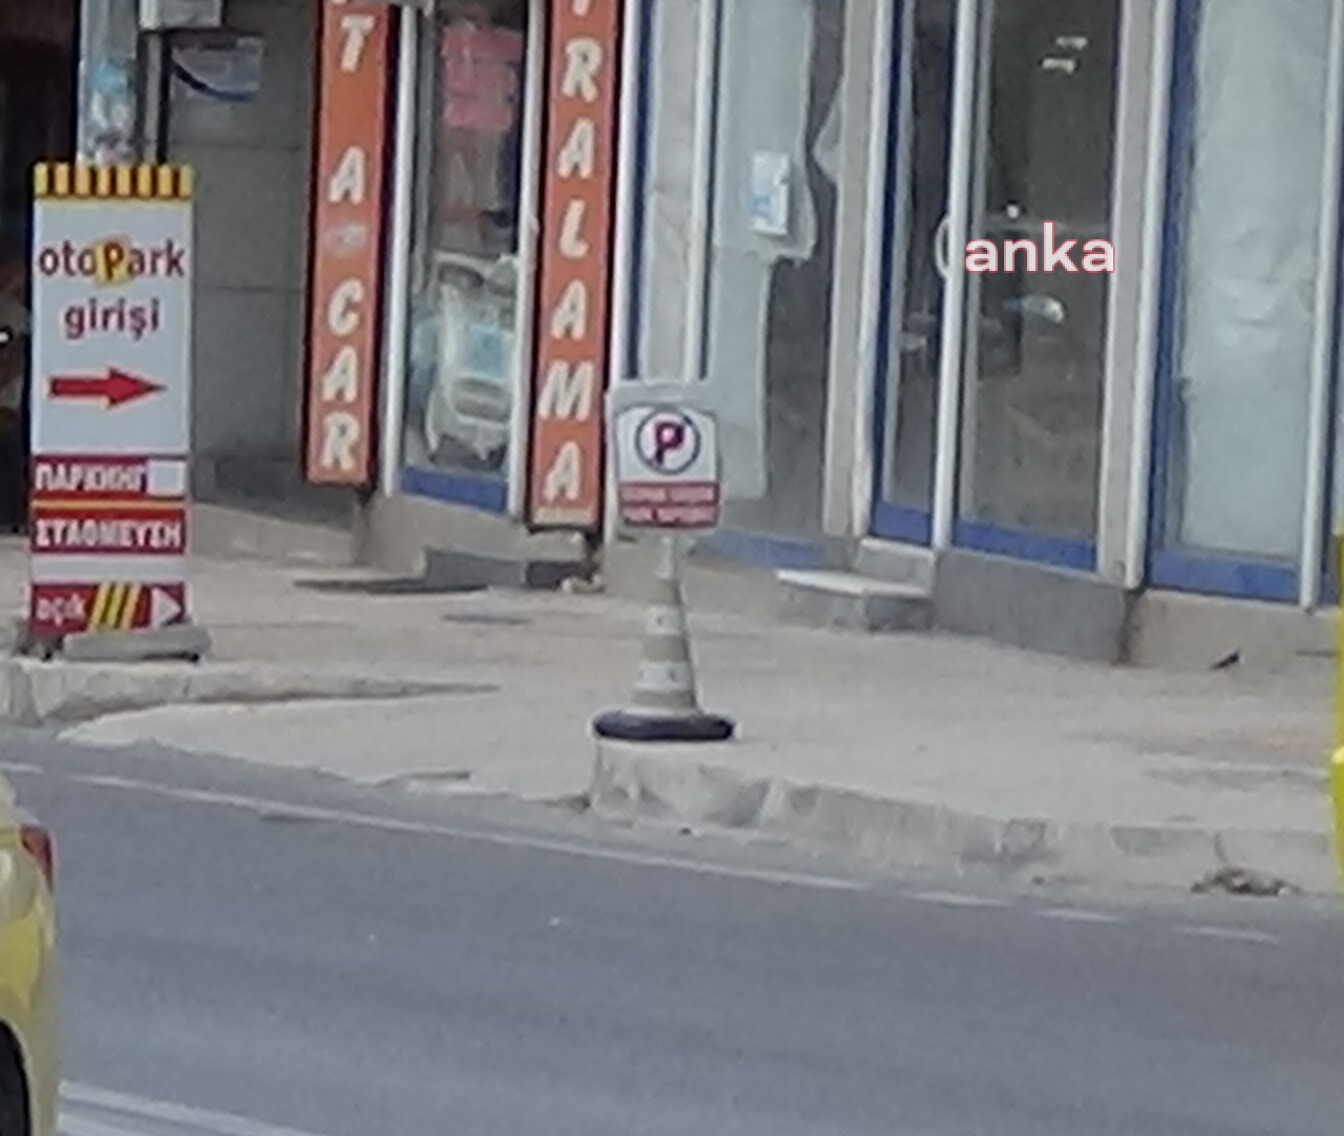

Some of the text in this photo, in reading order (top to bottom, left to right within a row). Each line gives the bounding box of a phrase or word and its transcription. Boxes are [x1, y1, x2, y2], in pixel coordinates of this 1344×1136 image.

[328, 146, 366, 205] A
[38, 237, 186, 281] otoPark
[537, 0, 603, 501] RALAMA
[64, 297, 160, 341] girişi
[321, 278, 365, 471] CAR
